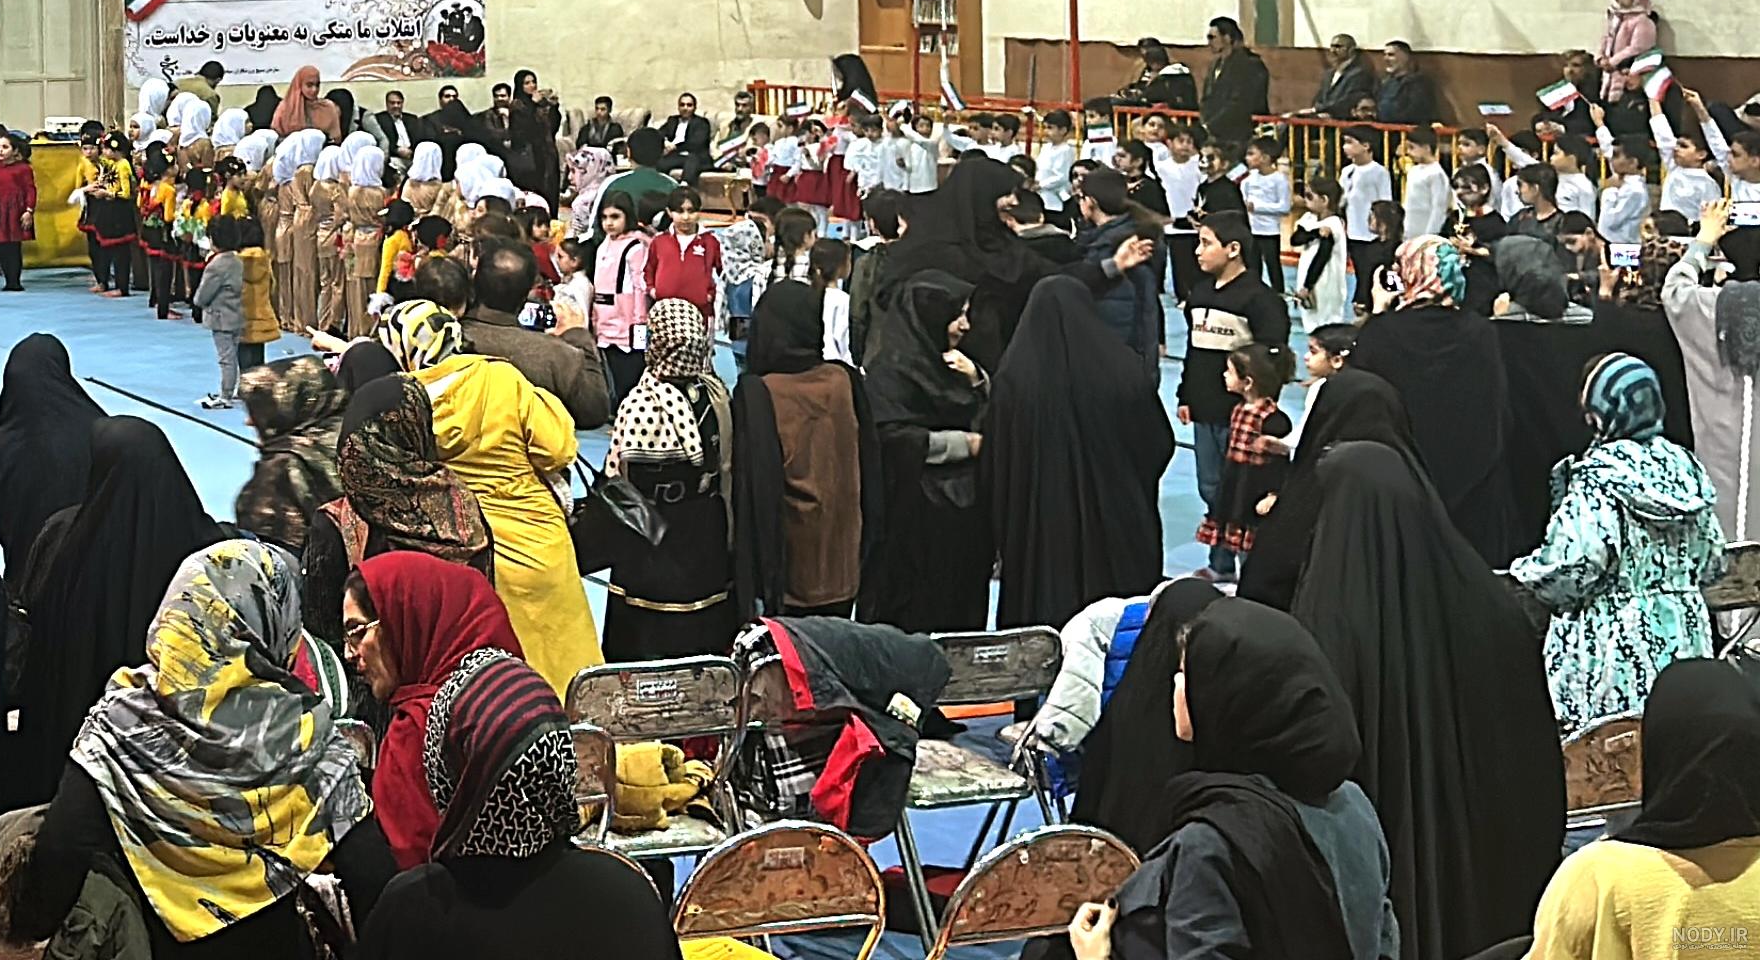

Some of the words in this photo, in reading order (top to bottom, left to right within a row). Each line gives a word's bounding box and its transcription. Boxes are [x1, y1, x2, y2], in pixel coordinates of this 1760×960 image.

[214, 30, 225, 50] و
[228, 23, 289, 48] معنویات
[293, 24, 308, 43] به
[312, 20, 353, 46] متکی
[356, 19, 371, 39] ما
[375, 17, 422, 45] انقلاب
